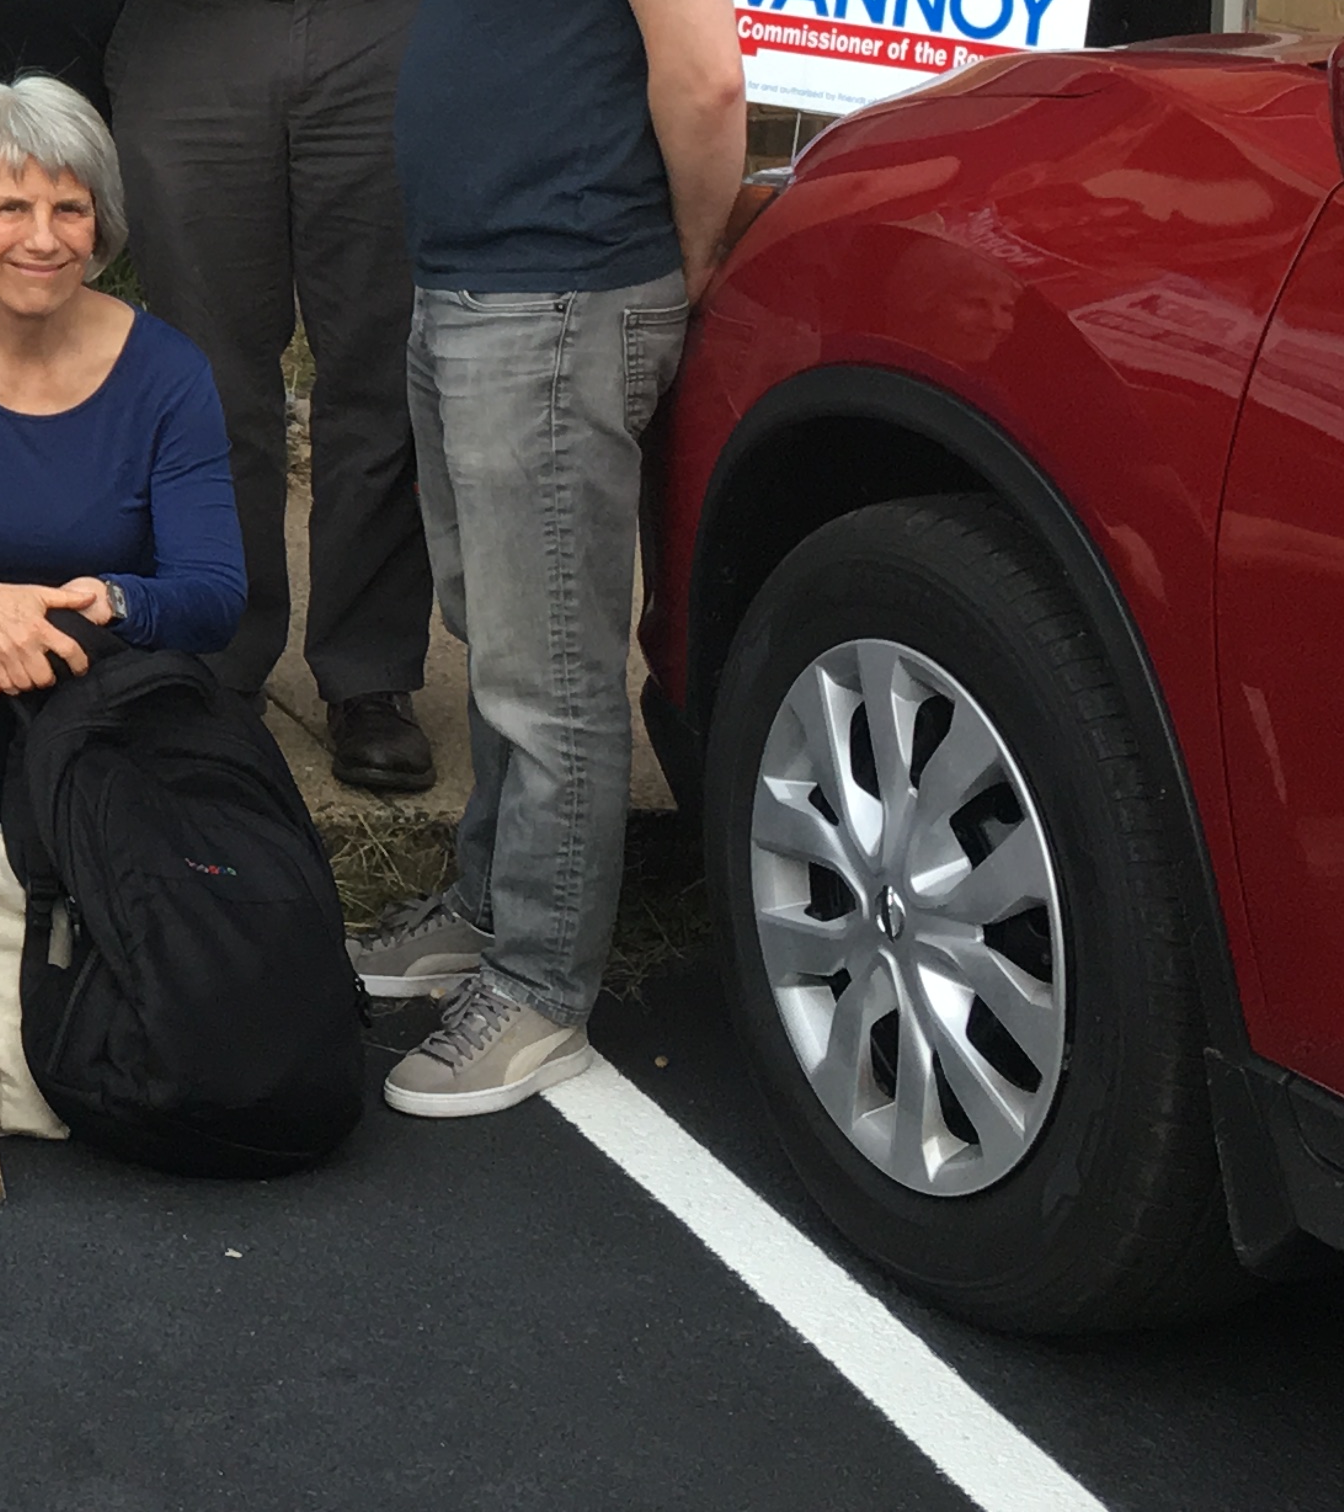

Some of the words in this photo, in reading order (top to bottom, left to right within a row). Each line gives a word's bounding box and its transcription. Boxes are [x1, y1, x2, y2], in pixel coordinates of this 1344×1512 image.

[737, 15, 884, 58] Commissioner
[887, 37, 911, 61] of
[914, 41, 947, 67] the
